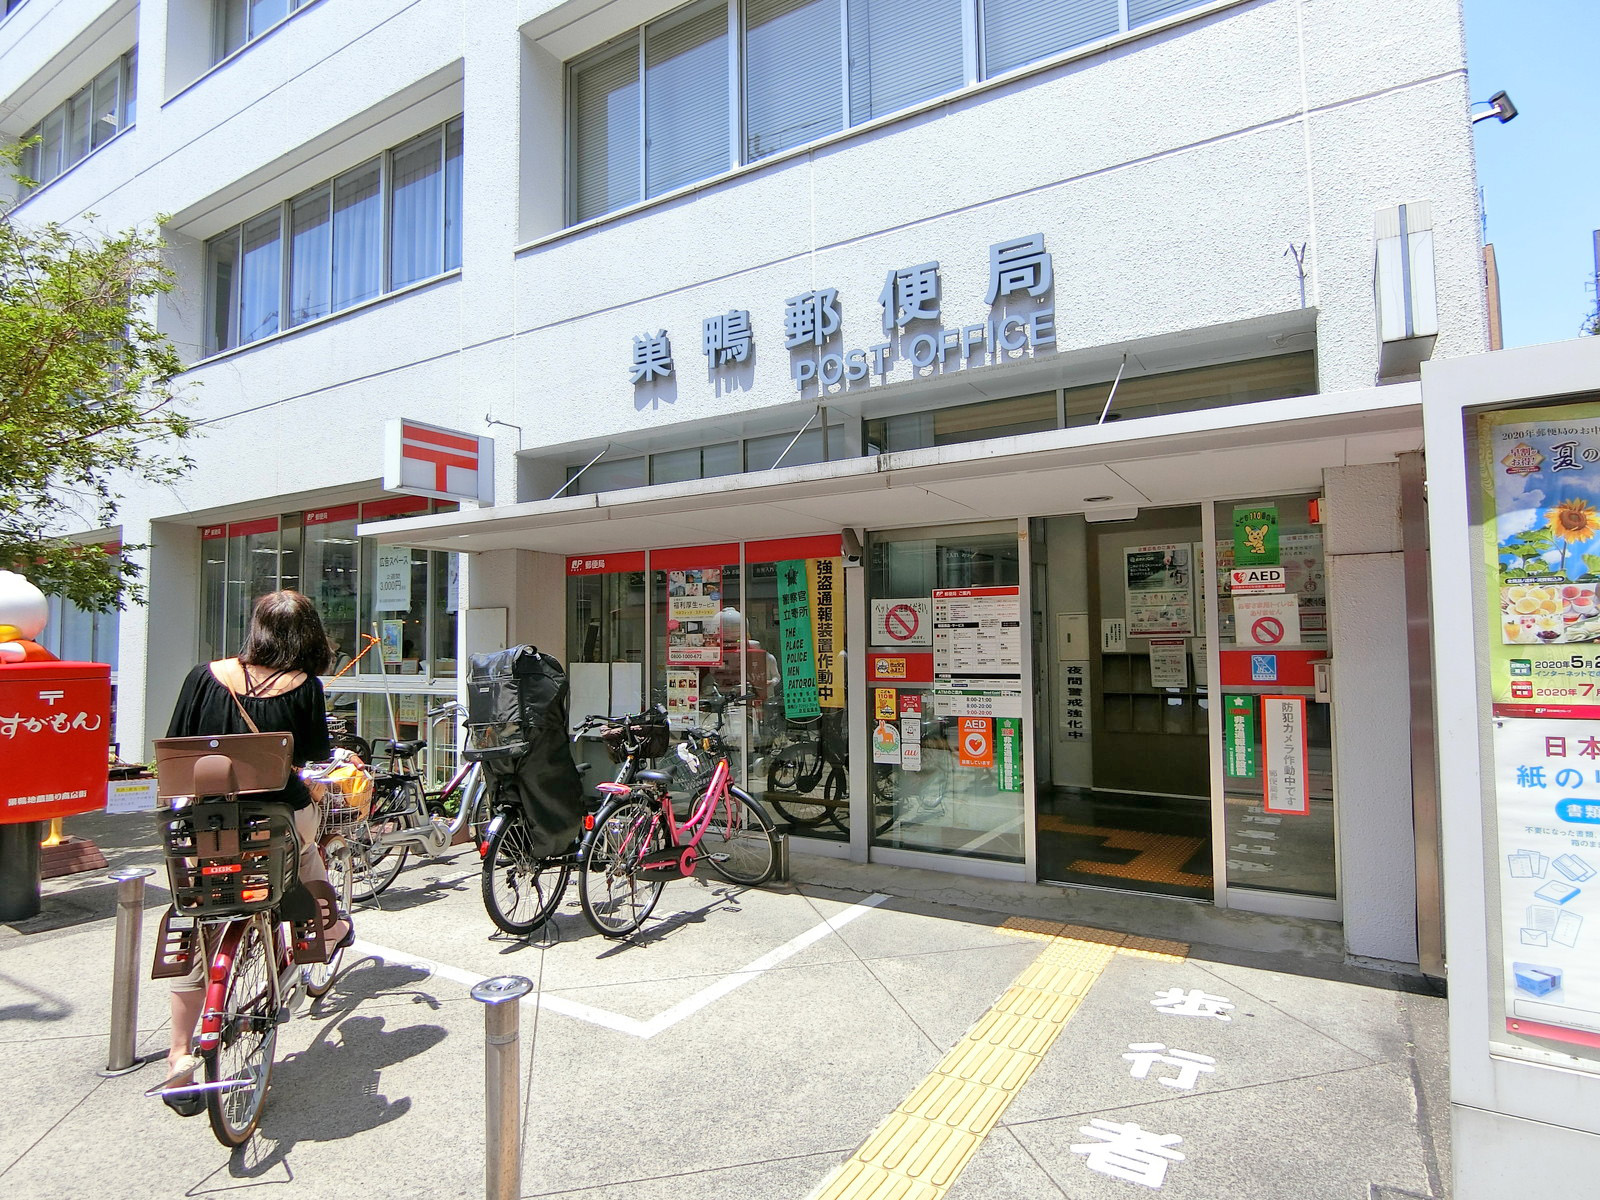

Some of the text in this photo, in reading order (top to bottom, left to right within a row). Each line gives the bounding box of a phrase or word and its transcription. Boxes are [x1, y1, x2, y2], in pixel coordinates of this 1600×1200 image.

[630, 232, 1053, 384] 巣鴨郵便局
[796, 308, 1057, 392] POST OFFICE
[379, 555, 409, 567] 広告スペース
[585, 559, 605, 570] 郵便局
[1248, 570, 1281, 582] AED
[782, 591, 807, 605] 警察官
[783, 606, 808, 621] 立寄所
[785, 627, 796, 638] THE
[817, 560, 833, 701] 強盗通報装置作動中
[785, 639, 804, 651] PLACE
[786, 651, 808, 664] POLICE
[787, 666, 800, 677] MEN
[788, 677, 815, 690] PATOROL
[1067, 666, 1083, 740] 夜間警戒強化中
[0, 711, 101, 740] すがもん
[964, 719, 987, 729] AED
[904, 749, 918, 757] au
[1281, 702, 1297, 806] 防犯カメラ作動中です
[1545, 736, 1600, 760] 日本
[1516, 764, 1600, 789] 紙の
[1570, 839, 1600, 848] 箱のま
[1070, 987, 1236, 1189] 歩行者
